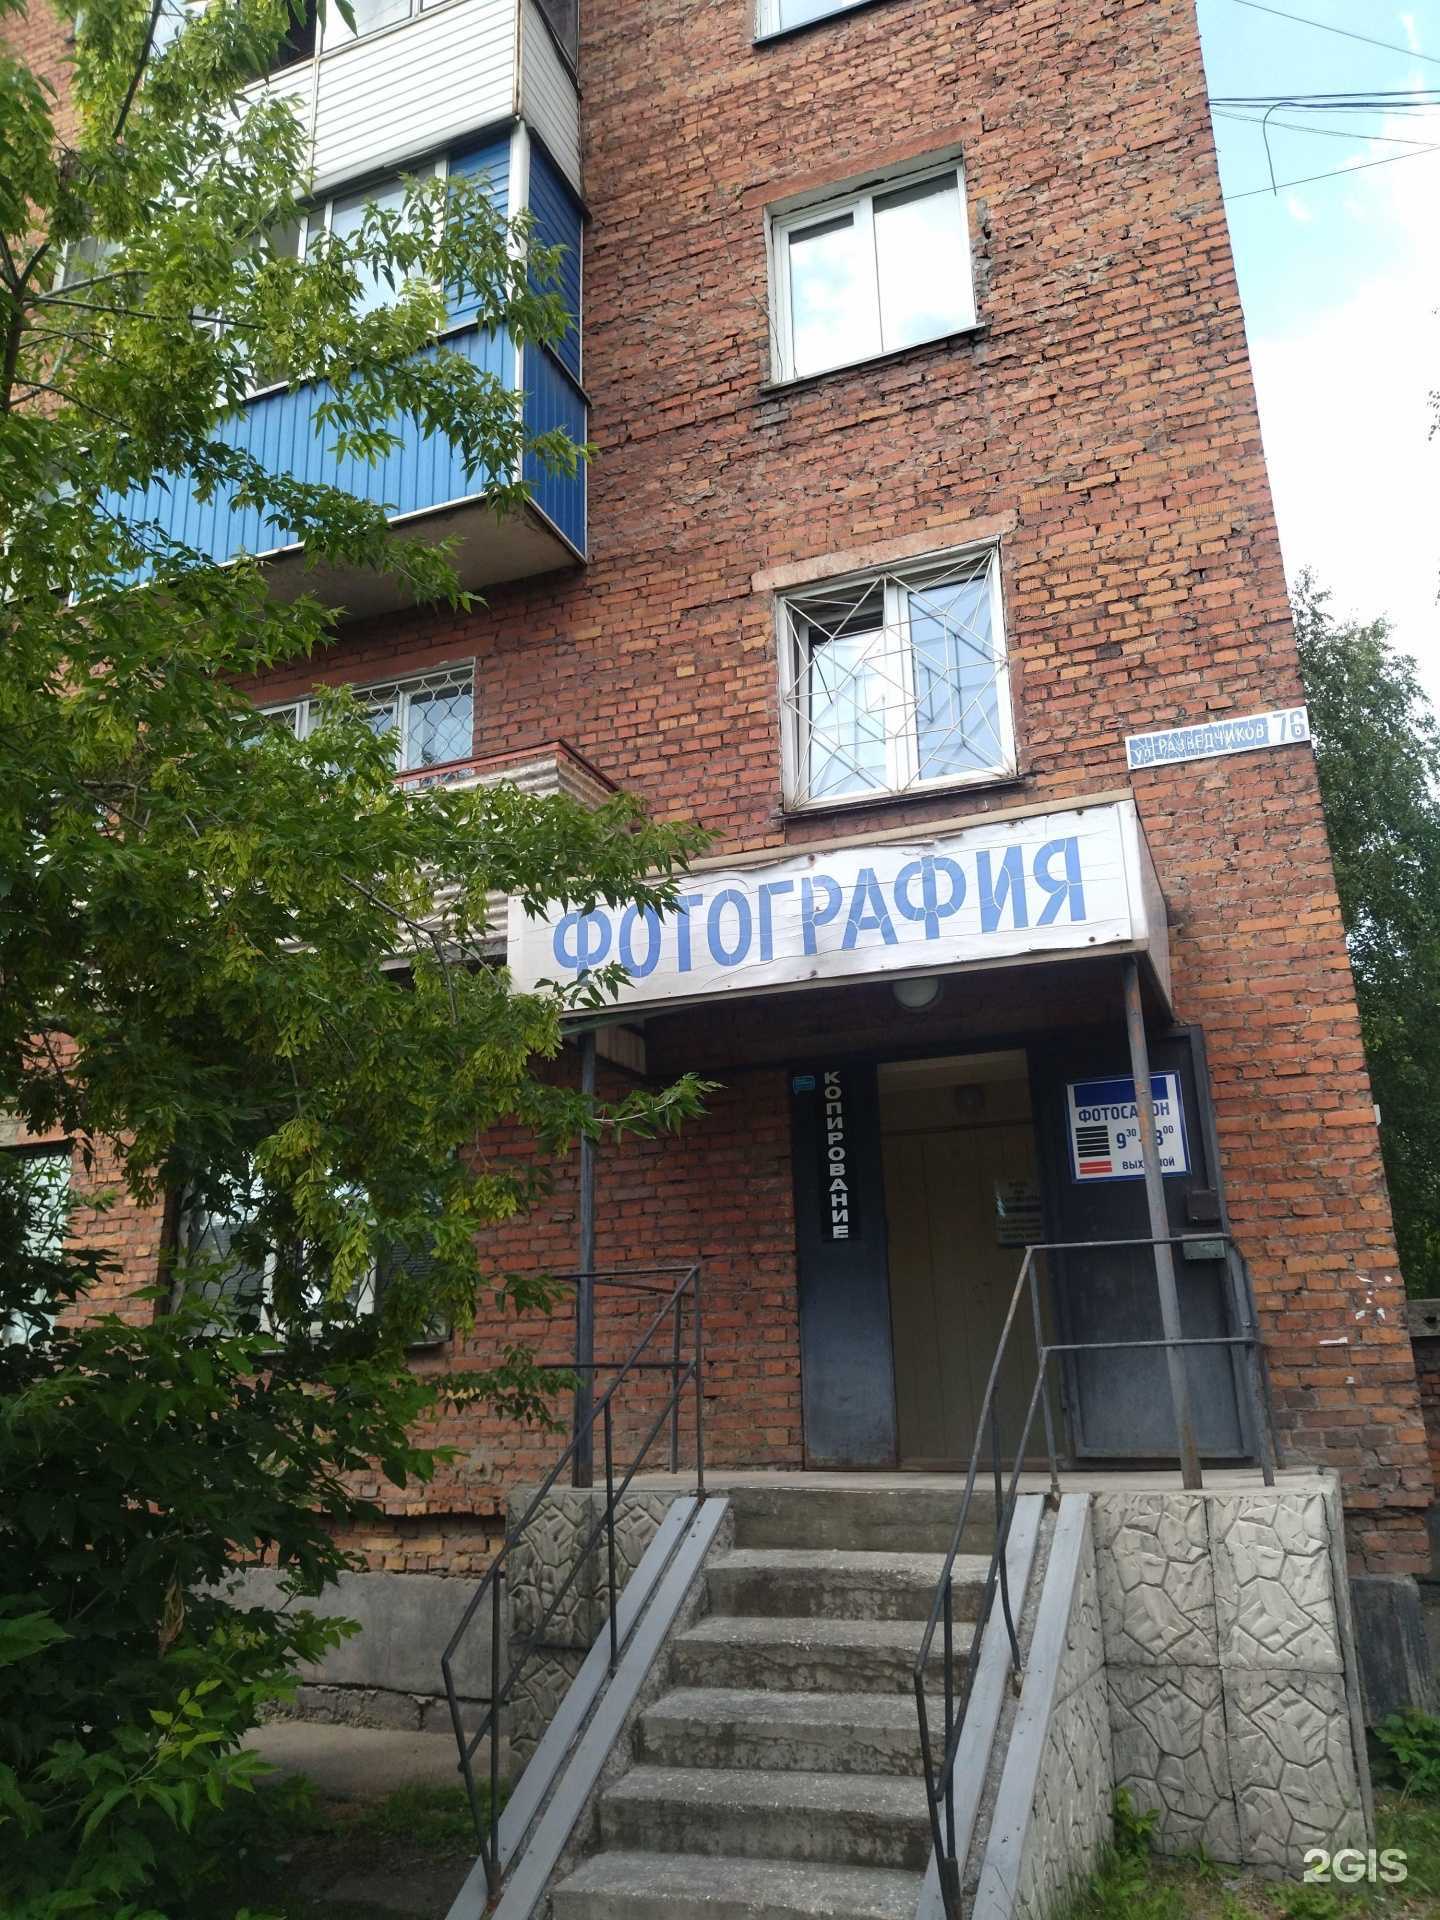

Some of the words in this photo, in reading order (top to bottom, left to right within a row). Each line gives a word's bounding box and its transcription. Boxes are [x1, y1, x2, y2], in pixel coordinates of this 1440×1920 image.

[1159, 723, 1265, 753] РАЗВЕДЧИКОВ
[552, 836, 1086, 979] ФОТОГРАФИЯ
[824, 1071, 849, 1239] КОПИРОВАНИЕ
[1078, 1102, 1170, 1123] ФОТОСАОН
